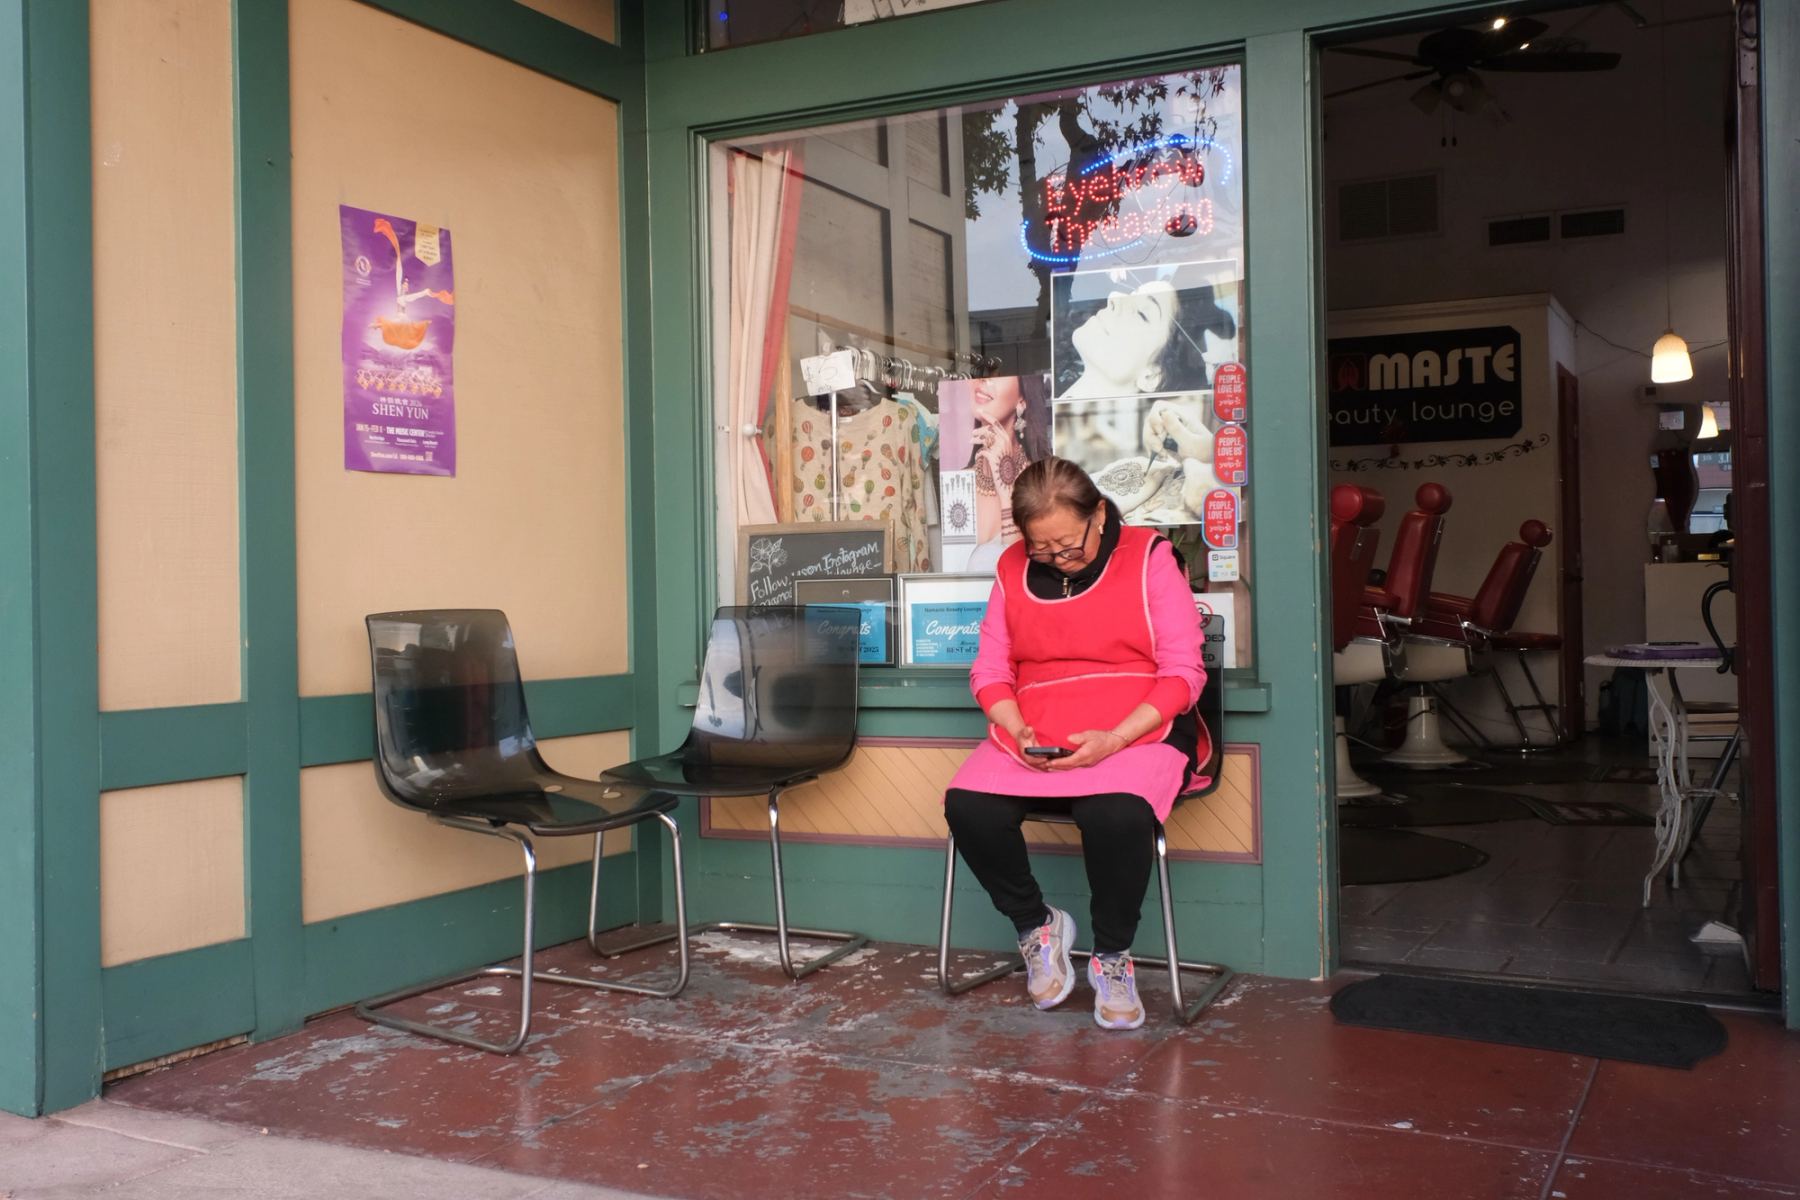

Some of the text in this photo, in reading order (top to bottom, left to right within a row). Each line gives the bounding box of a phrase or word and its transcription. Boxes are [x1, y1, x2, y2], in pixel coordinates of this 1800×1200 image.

[1045, 155, 1204, 217] Eyebrow
[1044, 197, 1215, 254] Threading
[1218, 374, 1241, 384] PEOPLE
[1217, 384, 1232, 394] LOVE
[372, 402, 429, 420] SHEN YUN
[1412, 400, 1515, 423] lounge
[1218, 437, 1241, 446] PEOPLE
[1217, 447, 1232, 457] LOVE
[1208, 501, 1231, 510] PEOPLE
[1207, 511, 1223, 520] LOVE
[926, 619, 980, 641] Congrats
